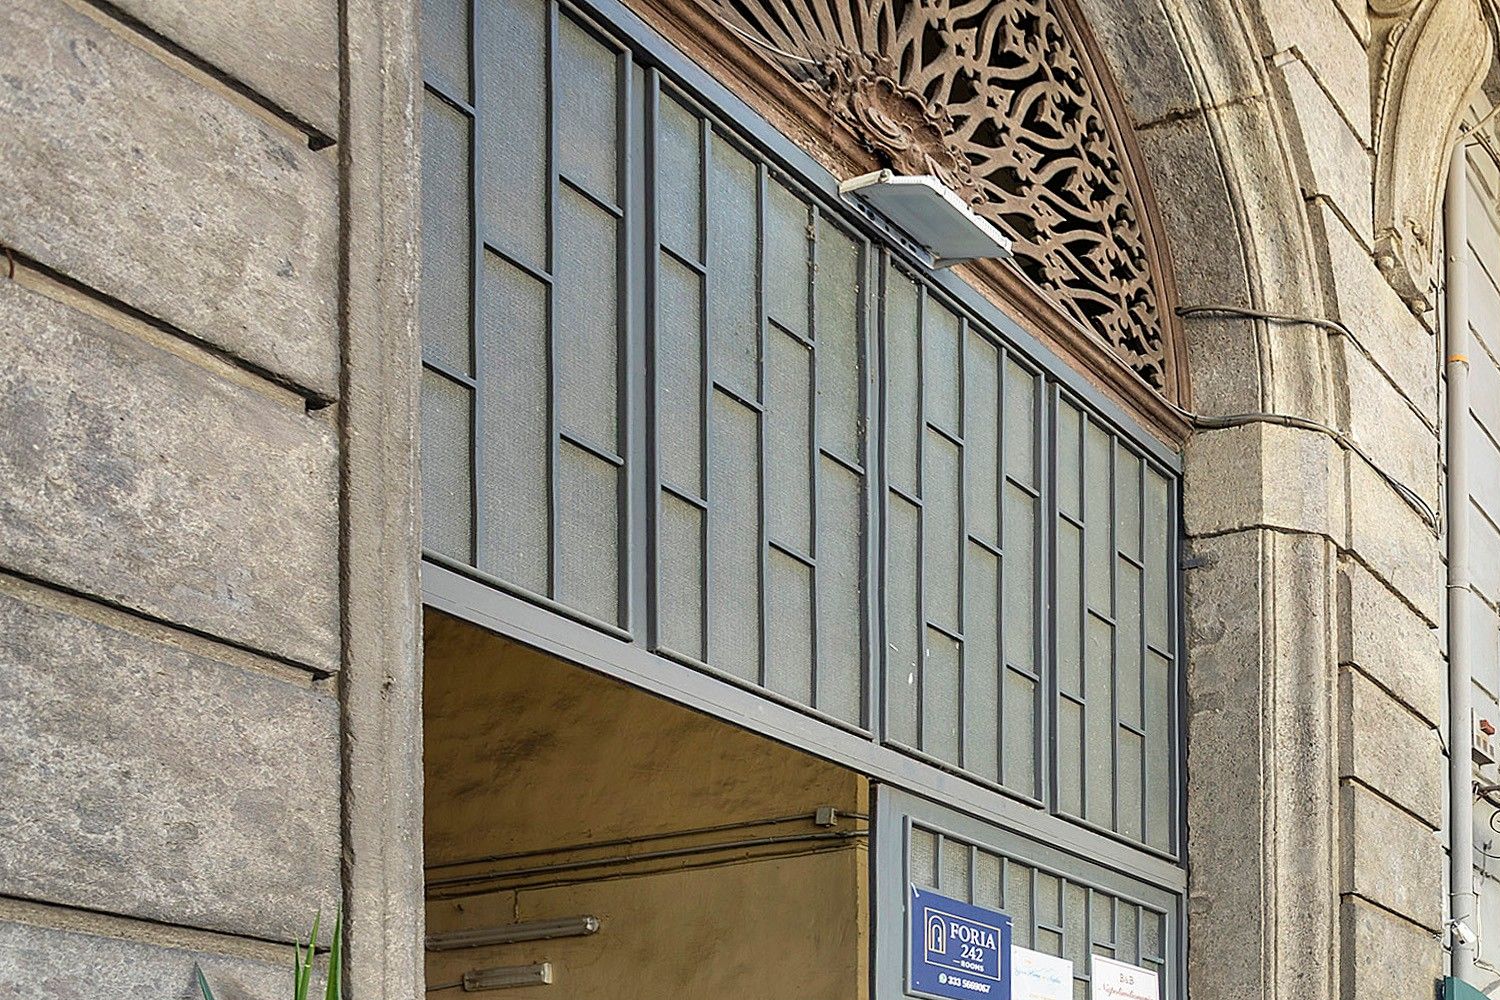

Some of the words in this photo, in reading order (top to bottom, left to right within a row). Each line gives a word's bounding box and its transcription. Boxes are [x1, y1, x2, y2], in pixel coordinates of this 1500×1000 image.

[949, 922, 997, 950] FORIA
[960, 944, 984, 963] 242
[960, 960, 985, 972] ROOMS
